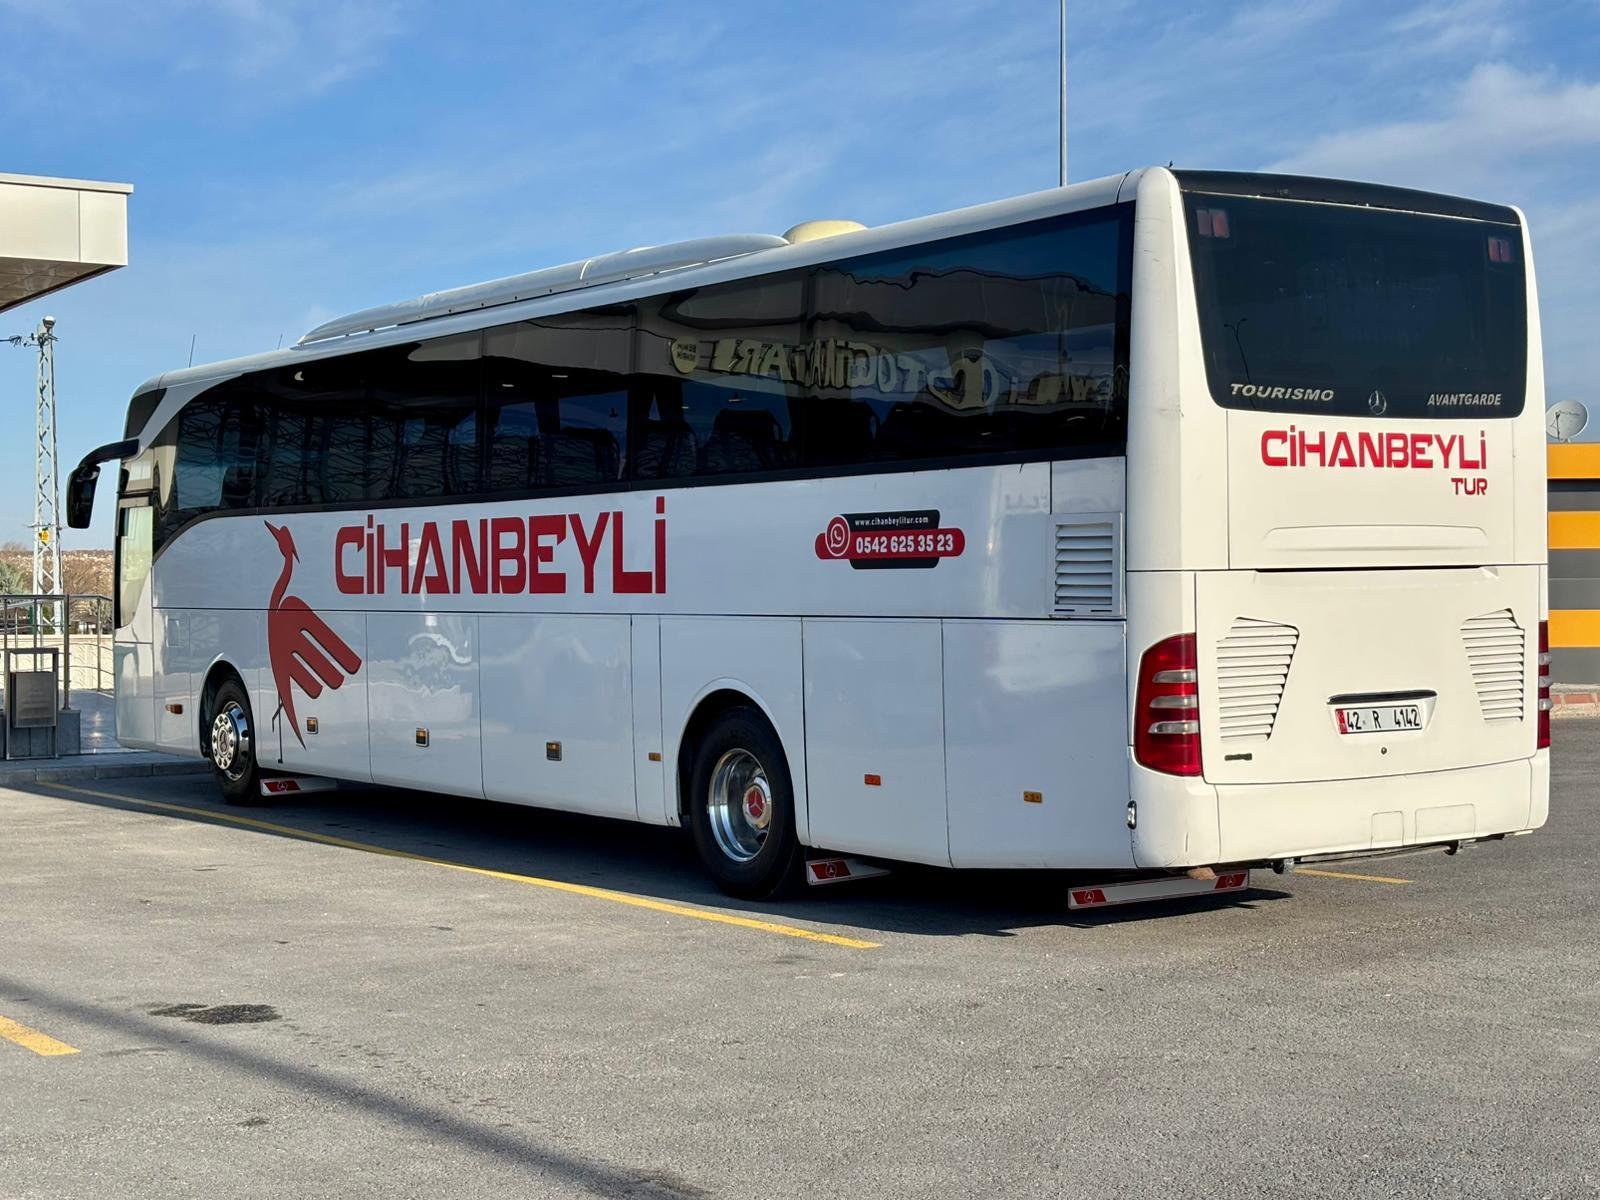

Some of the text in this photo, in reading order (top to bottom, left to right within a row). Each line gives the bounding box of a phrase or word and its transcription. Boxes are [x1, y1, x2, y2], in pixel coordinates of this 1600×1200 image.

[1230, 383, 1335, 401] TOURISMO
[1427, 393, 1502, 406] AVANTGARDE
[1260, 425, 1487, 469] CİHANBEYLİ
[1450, 477, 1488, 495] TUR
[854, 516, 929, 526] www.cihanbeylitur.com
[335, 496, 666, 594] CİHANBEYLİ
[856, 533, 954, 553] 0542 625 35 23
[1346, 708, 1420, 730] 42 R 4142
